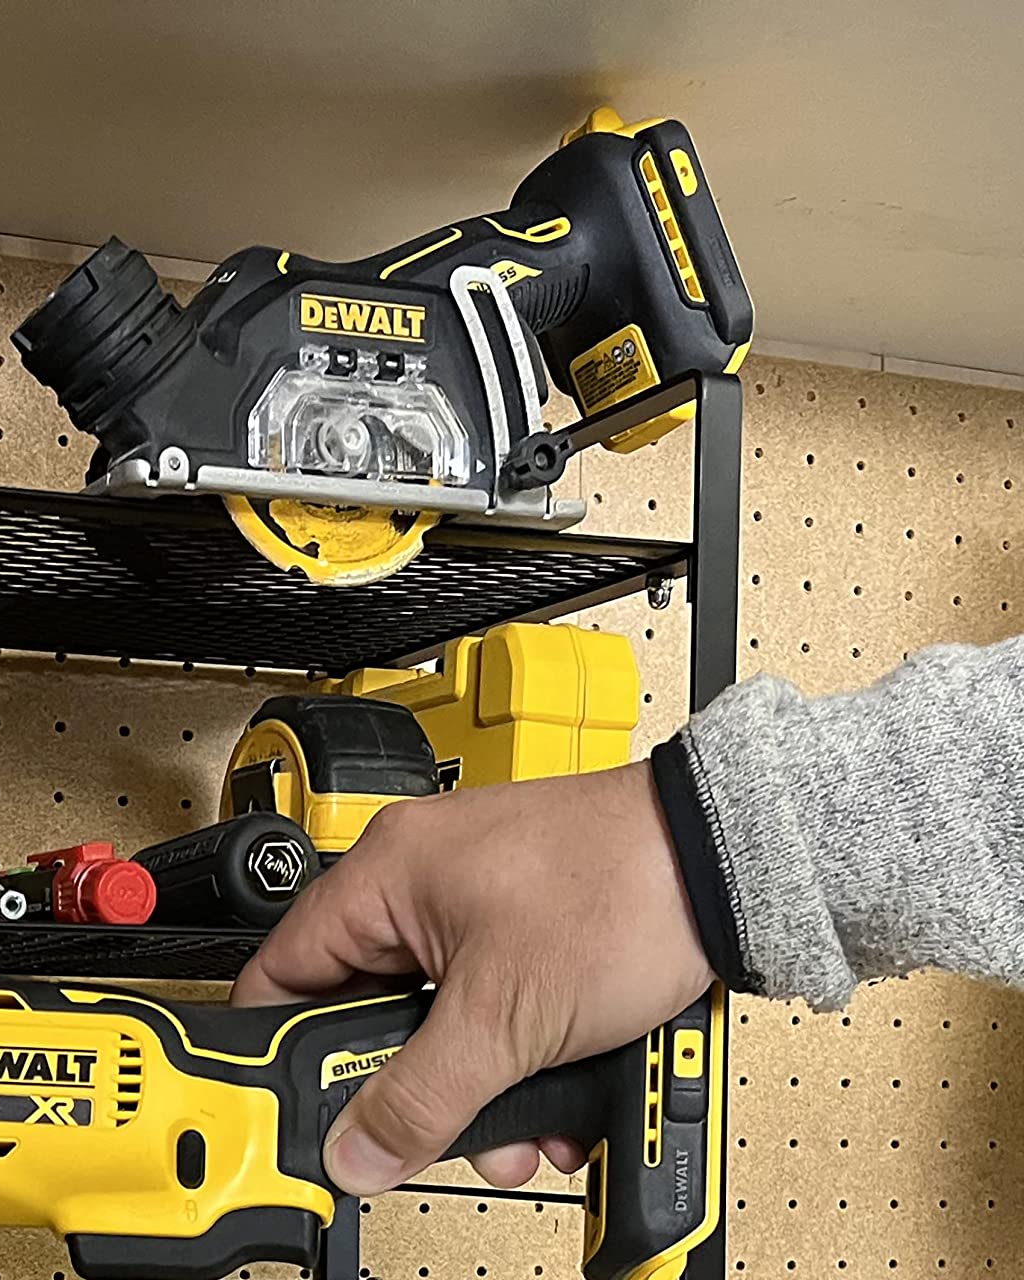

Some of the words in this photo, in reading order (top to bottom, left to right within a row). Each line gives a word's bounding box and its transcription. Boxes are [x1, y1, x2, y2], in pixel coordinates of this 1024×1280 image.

[300, 297, 426, 339] DEWALT
[23, 1095, 79, 1127] XR
[674, 1149, 689, 1212] DEWALT
